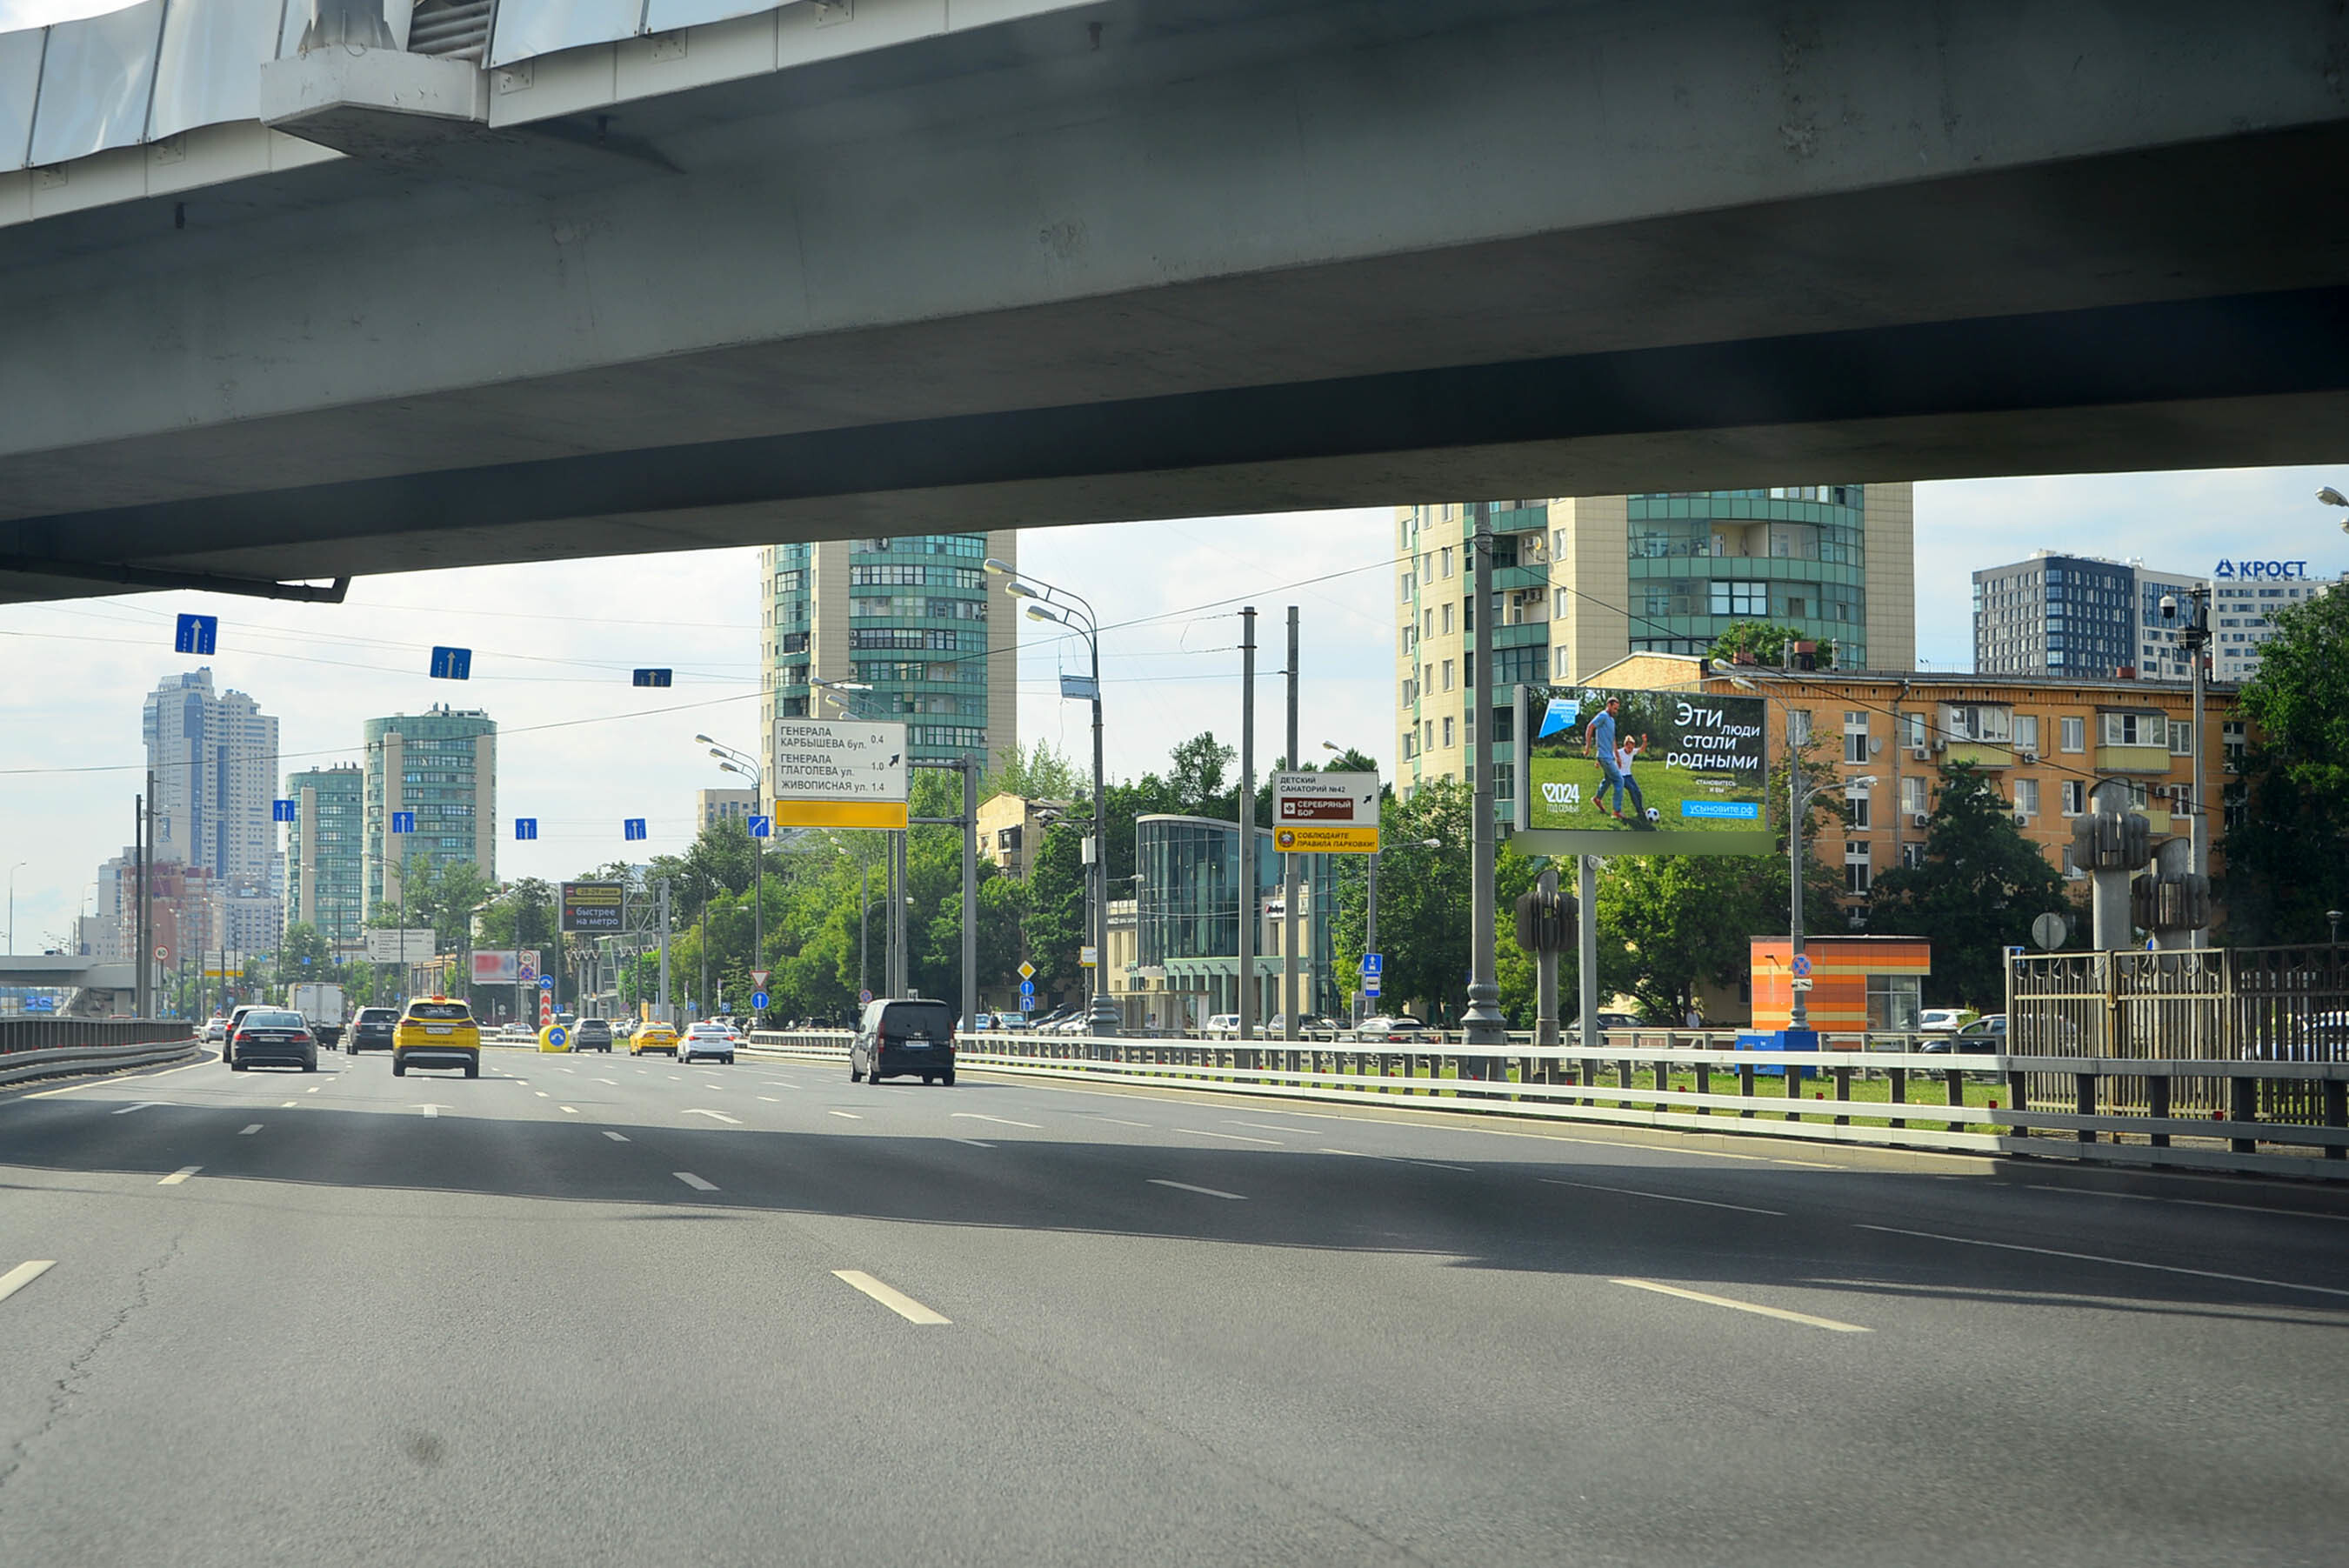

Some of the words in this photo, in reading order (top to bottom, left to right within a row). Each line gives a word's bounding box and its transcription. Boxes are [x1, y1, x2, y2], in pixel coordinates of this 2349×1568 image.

[2239, 561, 2307, 577] КРОСТ
[1674, 703, 1723, 727] Эти
[1720, 724, 1760, 737] люди
[780, 726, 832, 737] ГЕНЕРАЛА
[780, 738, 844, 748] КАРБЫШЕВА
[847, 739, 867, 751] бул.
[871, 735, 884, 744] 0.4
[1683, 735, 1737, 750] стали
[780, 754, 832, 764] ГЕНЕРАЛА
[1665, 752, 1758, 770] родными
[781, 765, 838, 776] ГЛАГОЛЕВА
[841, 769, 855, 778] ул.
[871, 762, 884, 771] 1.0
[782, 780, 852, 791] ЖИВОПИСНАЯ
[855, 784, 868, 793] ул.
[871, 783, 884, 791] 1.4
[1543, 783, 1580, 804] 2024
[576, 907, 616, 917] быстрее
